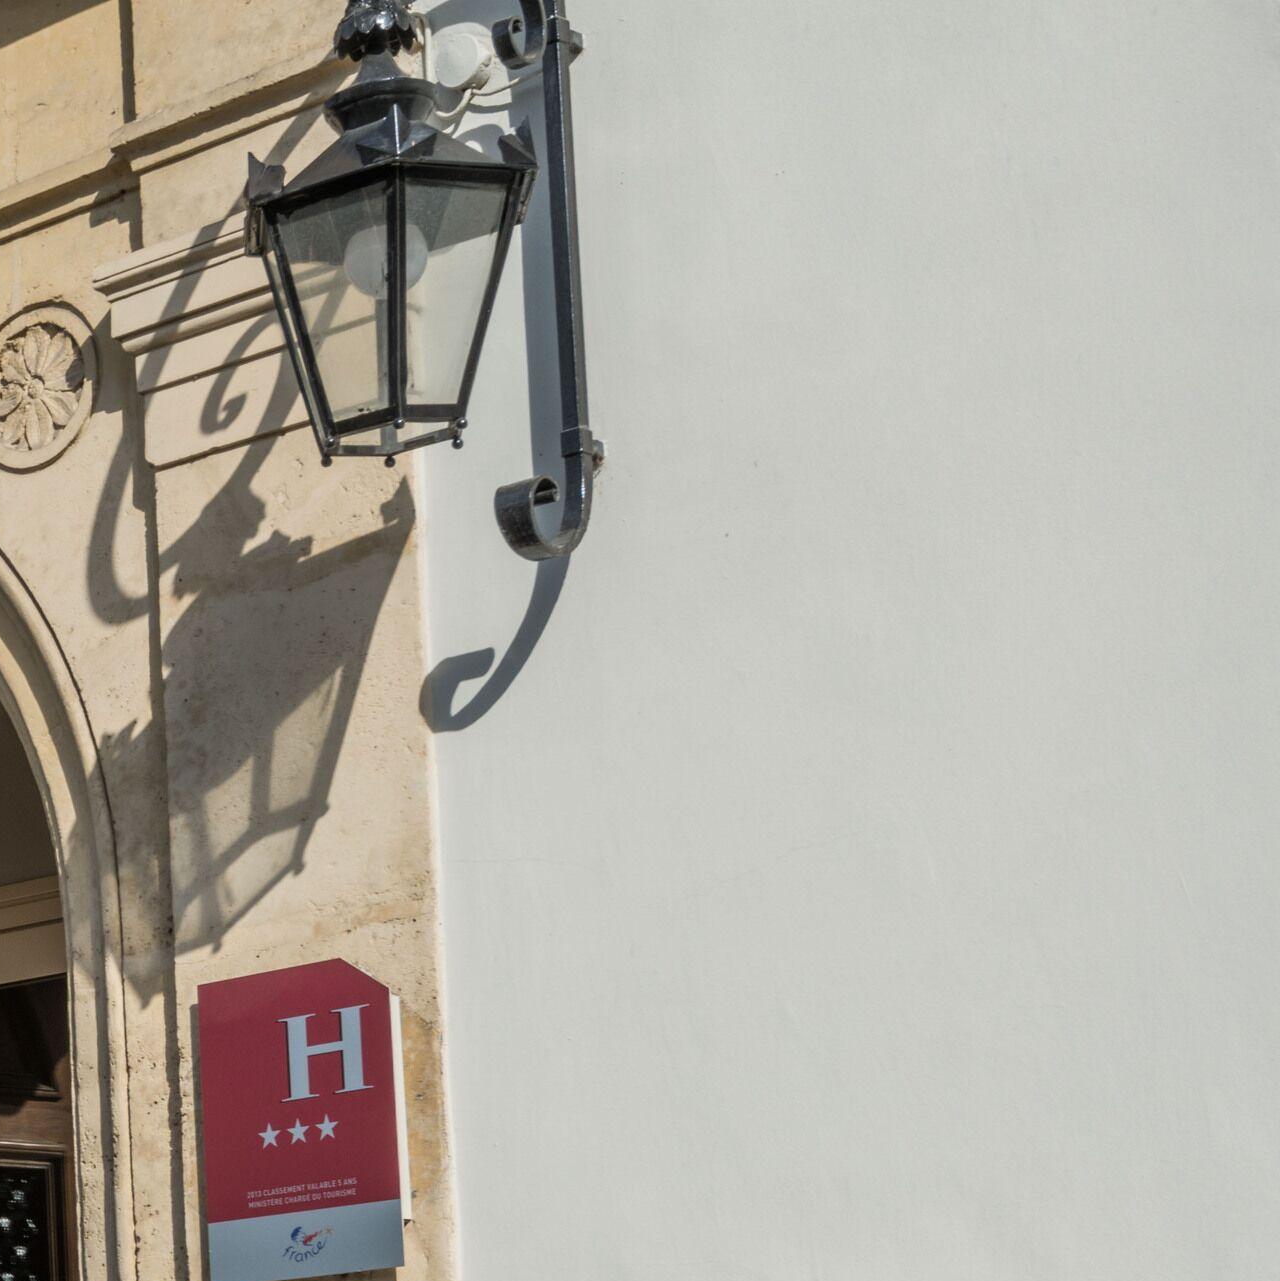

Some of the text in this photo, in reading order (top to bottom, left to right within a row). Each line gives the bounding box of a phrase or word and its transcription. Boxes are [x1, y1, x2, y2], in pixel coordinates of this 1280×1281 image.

[277, 1003, 375, 1102] H
[263, 1184, 305, 1196] CLASSEMENT
[307, 1180, 336, 1190] VALABLE
[343, 1177, 358, 1185] ANS
[323, 1188, 356, 1198] TOURISME
